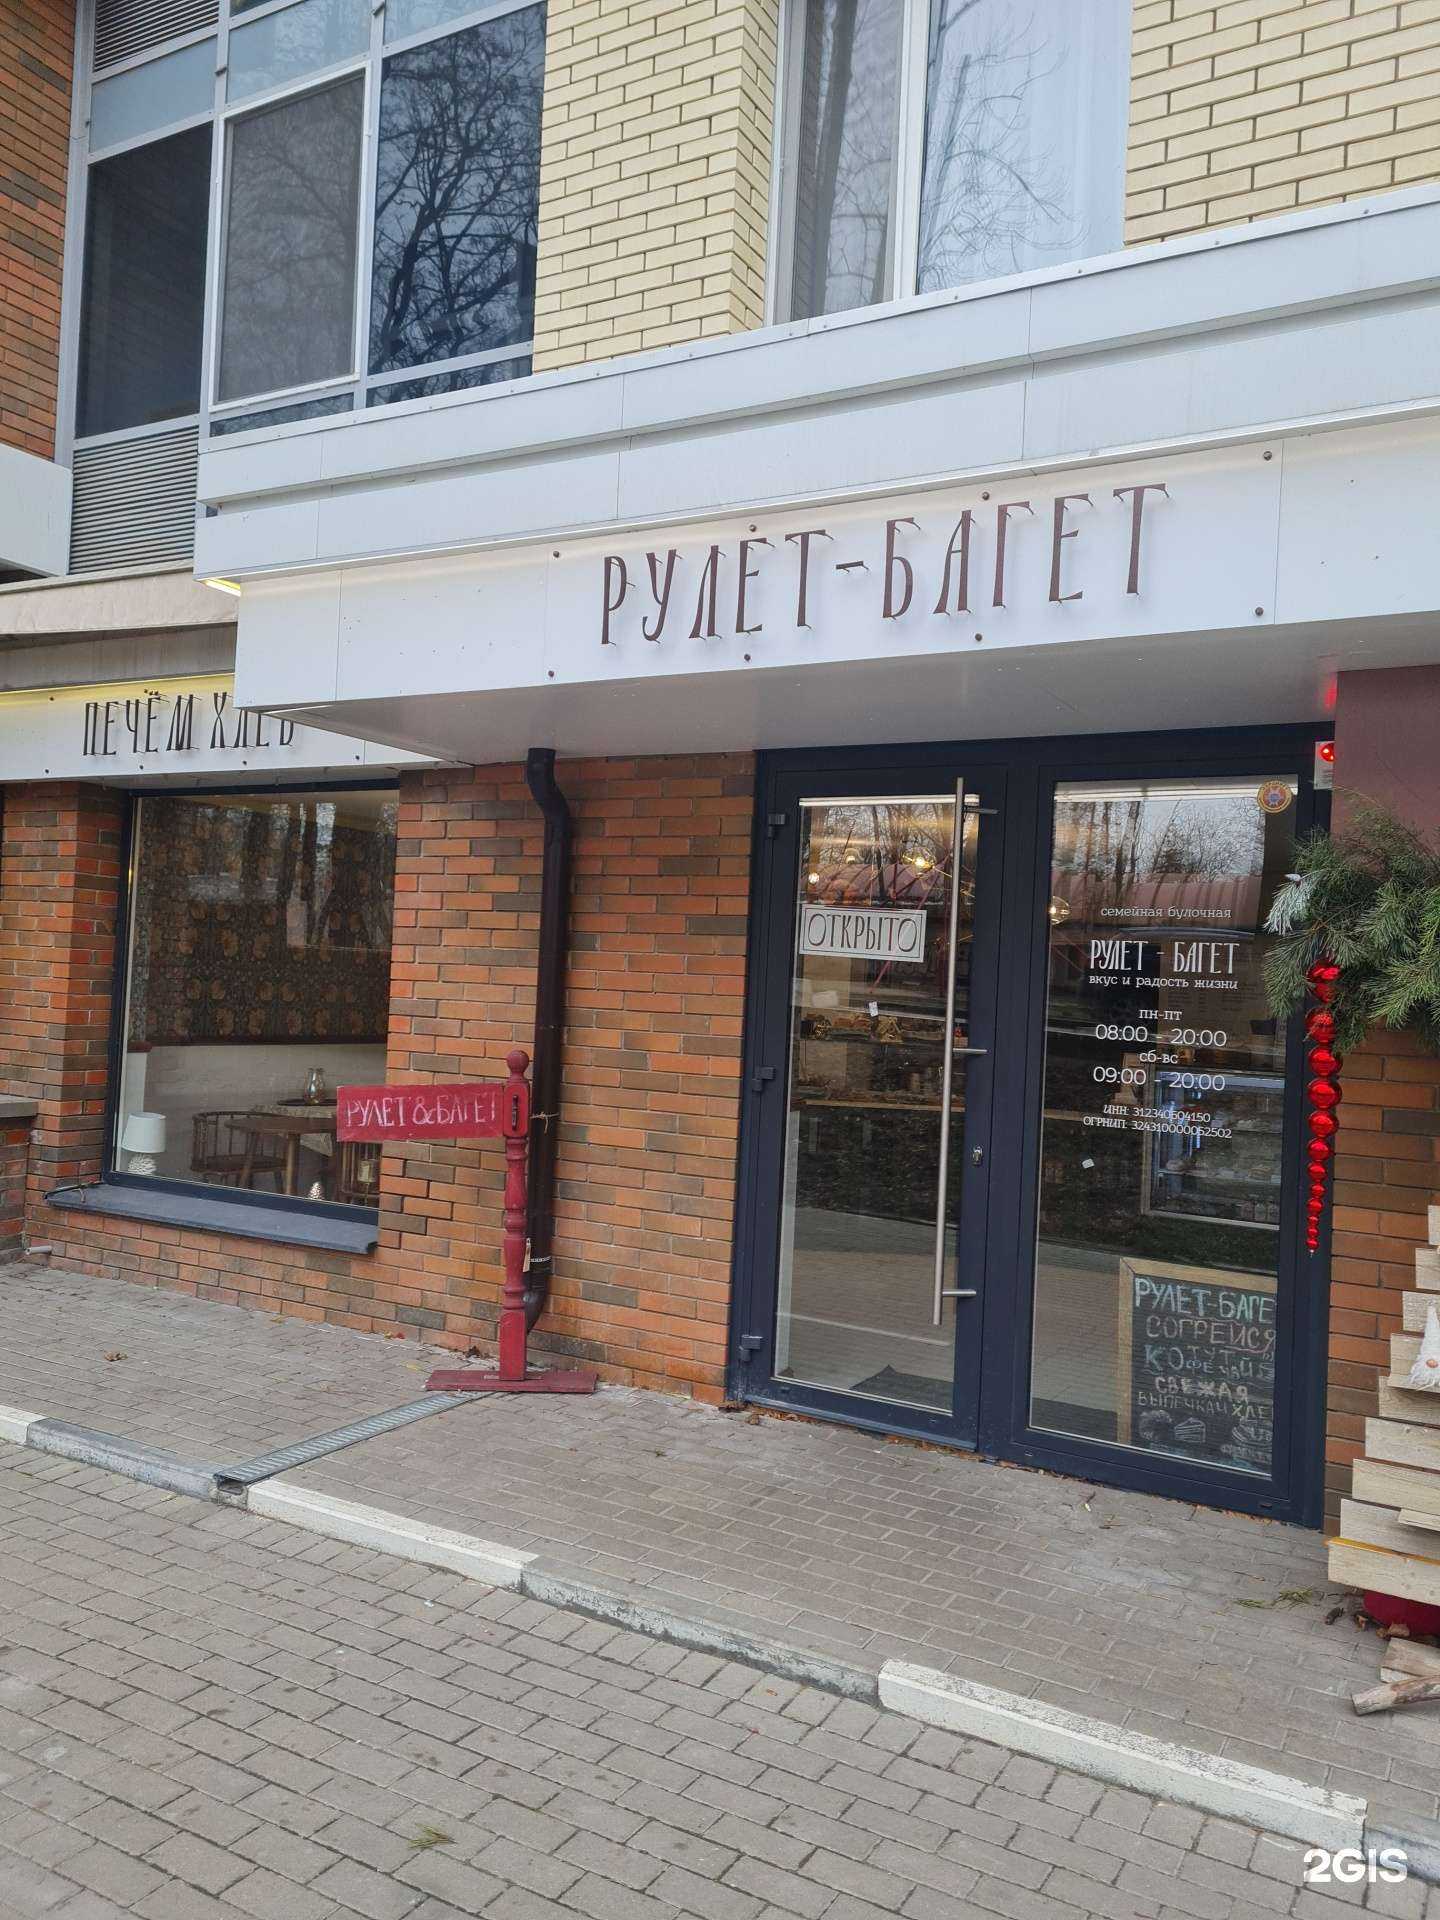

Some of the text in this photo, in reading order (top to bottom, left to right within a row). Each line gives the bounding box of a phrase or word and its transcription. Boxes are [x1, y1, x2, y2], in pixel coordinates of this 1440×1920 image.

[600, 483, 1168, 645] РУЛЕТ-БАГЕТ
[83, 689, 196, 756] ПЕЧЁМ
[1100, 905, 1232, 919] семейная булочная
[808, 913, 918, 952] ОТКРЫТО
[1090, 939, 1149, 971] РУЛЕТ
[1173, 942, 1240, 974] БАГЕТ
[1089, 975, 1238, 990] вкус и радость жизни
[1138, 1008, 1183, 1021] пн-пт
[1095, 1024, 1148, 1042] 08:00
[1170, 1028, 1227, 1047] 20:00
[1139, 1050, 1179, 1065] сб-вс
[1093, 1067, 1147, 1086] 09:00
[1169, 1072, 1226, 1091] 20:00
